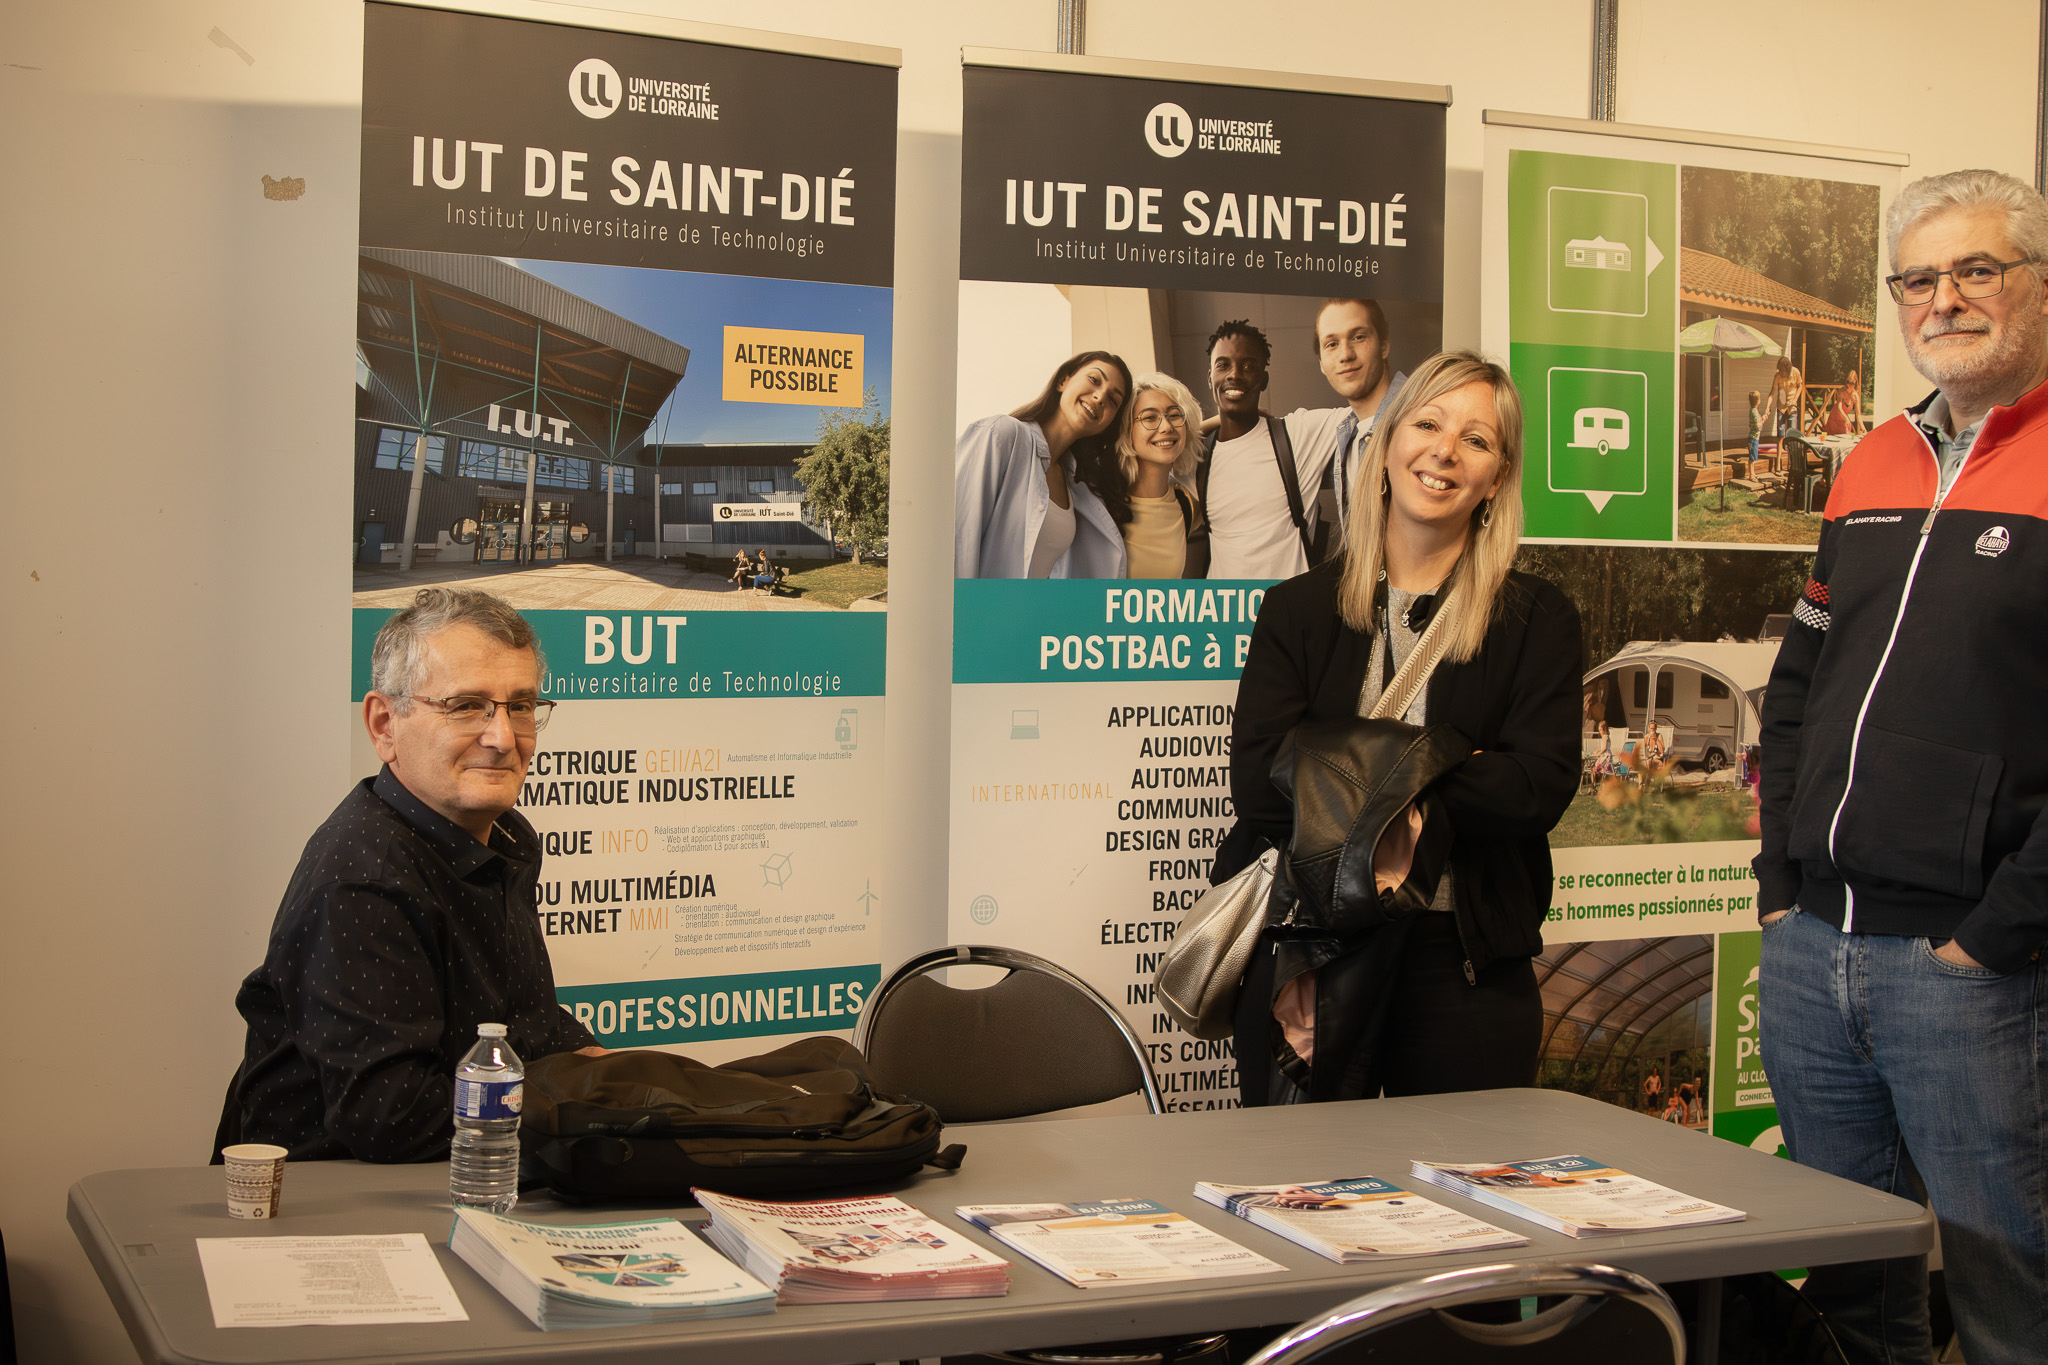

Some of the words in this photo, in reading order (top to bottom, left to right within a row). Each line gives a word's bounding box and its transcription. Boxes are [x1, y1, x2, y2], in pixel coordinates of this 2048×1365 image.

[628, 76, 711, 102] UNIVERSITÉ
[628, 95, 647, 112] DE
[651, 98, 719, 121] LORRAINE
[1198, 118, 1273, 139] UNIVERSITÉ
[1198, 134, 1215, 149] DE
[1218, 136, 1281, 155] LORRAINE
[412, 136, 503, 193] IUT
[525, 147, 588, 202] DE
[610, 155, 855, 226] SAINT-DIÉ
[1006, 179, 1086, 228] IUT
[1106, 185, 1163, 233] DE
[1182, 189, 1407, 247] SAINT-DIÉ
[447, 203, 525, 230] Institut
[536, 210, 668, 242] Universitaire
[679, 223, 700, 244] de
[712, 226, 824, 258] Technologie
[1036, 238, 1105, 261] Institut
[1116, 243, 1235, 267] Universitaire
[1245, 249, 1264, 269] de
[1274, 251, 1379, 278] Technologie
[734, 343, 853, 369] ALTERNANCE
[749, 369, 839, 393] POSSIBLE
[487, 403, 574, 446] I.U.T.
[1874, 515, 1902, 523] RACING
[1975, 549, 1998, 558] RACING
[585, 615, 687, 665] BUT
[1040, 634, 1191, 671] POSTBAC
[1203, 633, 1221, 669] à
[540, 671, 678, 694] Universitaire
[689, 671, 712, 693] de
[723, 670, 841, 696] Technologie
[727, 753, 768, 762] Automatisme
[769, 753, 776, 762] et
[777, 751, 817, 762] Informatique
[818, 751, 852, 760] Industrielle
[515, 779, 629, 807] MATIQUE
[638, 775, 795, 803] INDUSTRIELLE
[972, 783, 1113, 803] INTERNATIONAL
[654, 825, 690, 835] Réalisation
[691, 823, 736, 835] d'applications
[741, 822, 778, 833] conception,
[779, 820, 828, 832] développement,
[829, 819, 859, 828] validation
[666, 835, 681, 844] Web
[682, 835, 689, 843] et
[691, 833, 730, 845] applications
[730, 832, 766, 843] graphiques
[602, 829, 649, 854] INFO
[714, 842, 723, 851] L3
[723, 843, 738, 852] pour
[760, 840, 770, 849] M1
[1106, 829, 1180, 852] DESIGN
[1149, 858, 1214, 881] FRONT
[1559, 874, 1575, 890] se
[1579, 867, 1673, 889] reconnecter
[1676, 864, 1686, 884] à
[1690, 864, 1704, 883] la
[1708, 864, 1757, 882] nature
[571, 870, 717, 904] MULTIMÉDIA
[630, 907, 669, 931] MMI
[674, 904, 702, 914] Création
[703, 902, 738, 913] numérique
[685, 911, 720, 921] orientation
[725, 908, 761, 918] audiovisuel
[1567, 901, 1635, 920] hommes
[1639, 893, 1724, 921] passionnés
[1727, 896, 1753, 915] par
[685, 919, 720, 929] orientation
[725, 916, 773, 927] communication
[775, 915, 781, 924] et
[782, 914, 803, 925] design
[804, 912, 836, 924] graphique
[674, 932, 703, 944] Stratégie
[704, 932, 713, 941] de
[714, 929, 763, 940] communication
[763, 927, 798, 939] numérique
[798, 927, 805, 935] et
[806, 925, 827, 937] design
[828, 922, 866, 934] d'expérience
[674, 945, 724, 957] Développement
[725, 944, 739, 953] web
[739, 944, 746, 952] et
[747, 940, 779, 952] dispositifs
[780, 939, 812, 950] interactifs
[1737, 1071, 1749, 1085] AU
